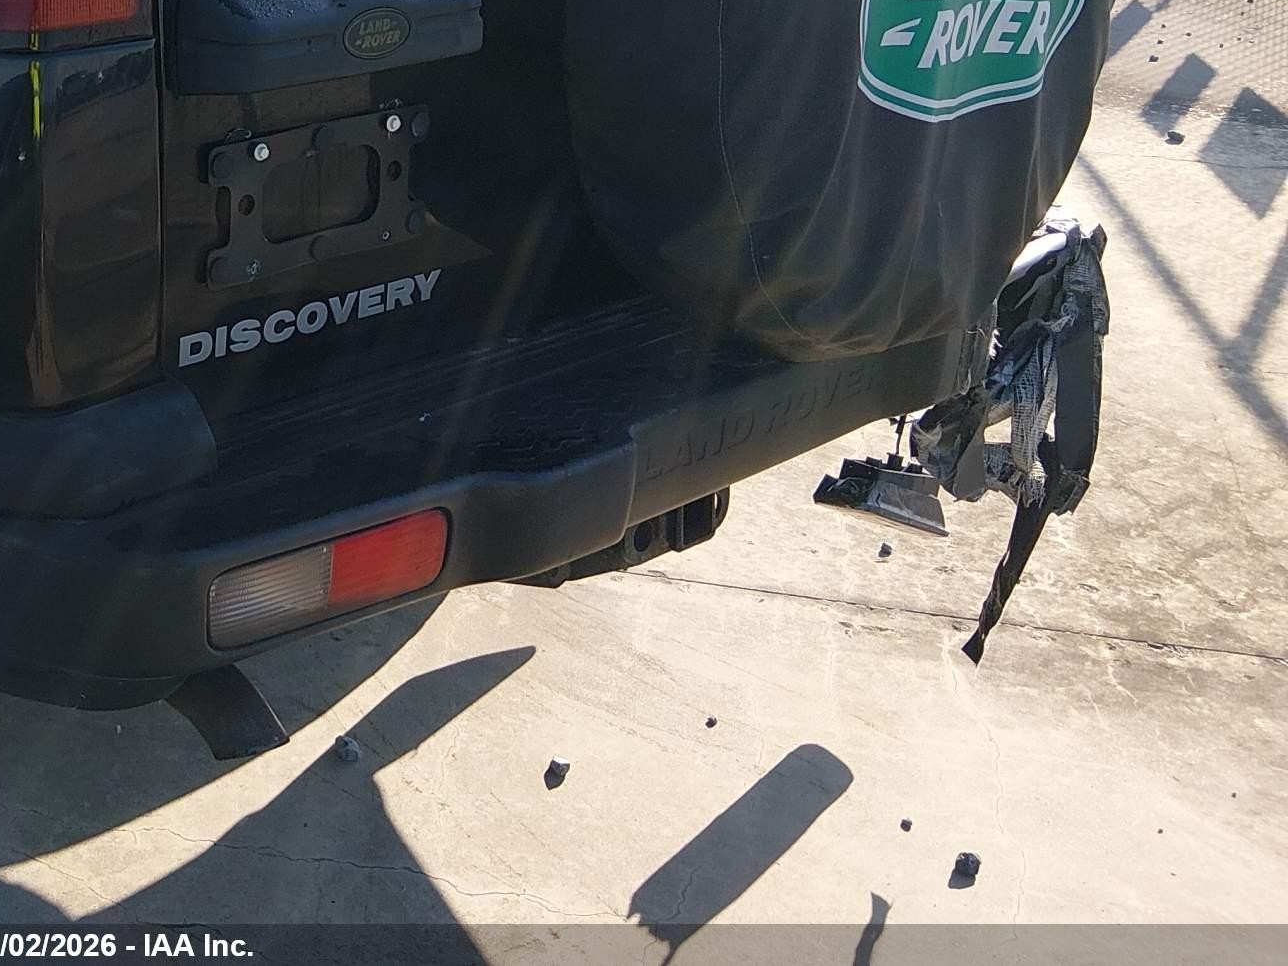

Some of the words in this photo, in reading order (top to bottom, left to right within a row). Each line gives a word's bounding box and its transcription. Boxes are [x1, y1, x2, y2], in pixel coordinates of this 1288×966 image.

[359, 17, 392, 36] LAND
[361, 29, 401, 50] ROVER
[178, 268, 442, 368] DISCOVERY
